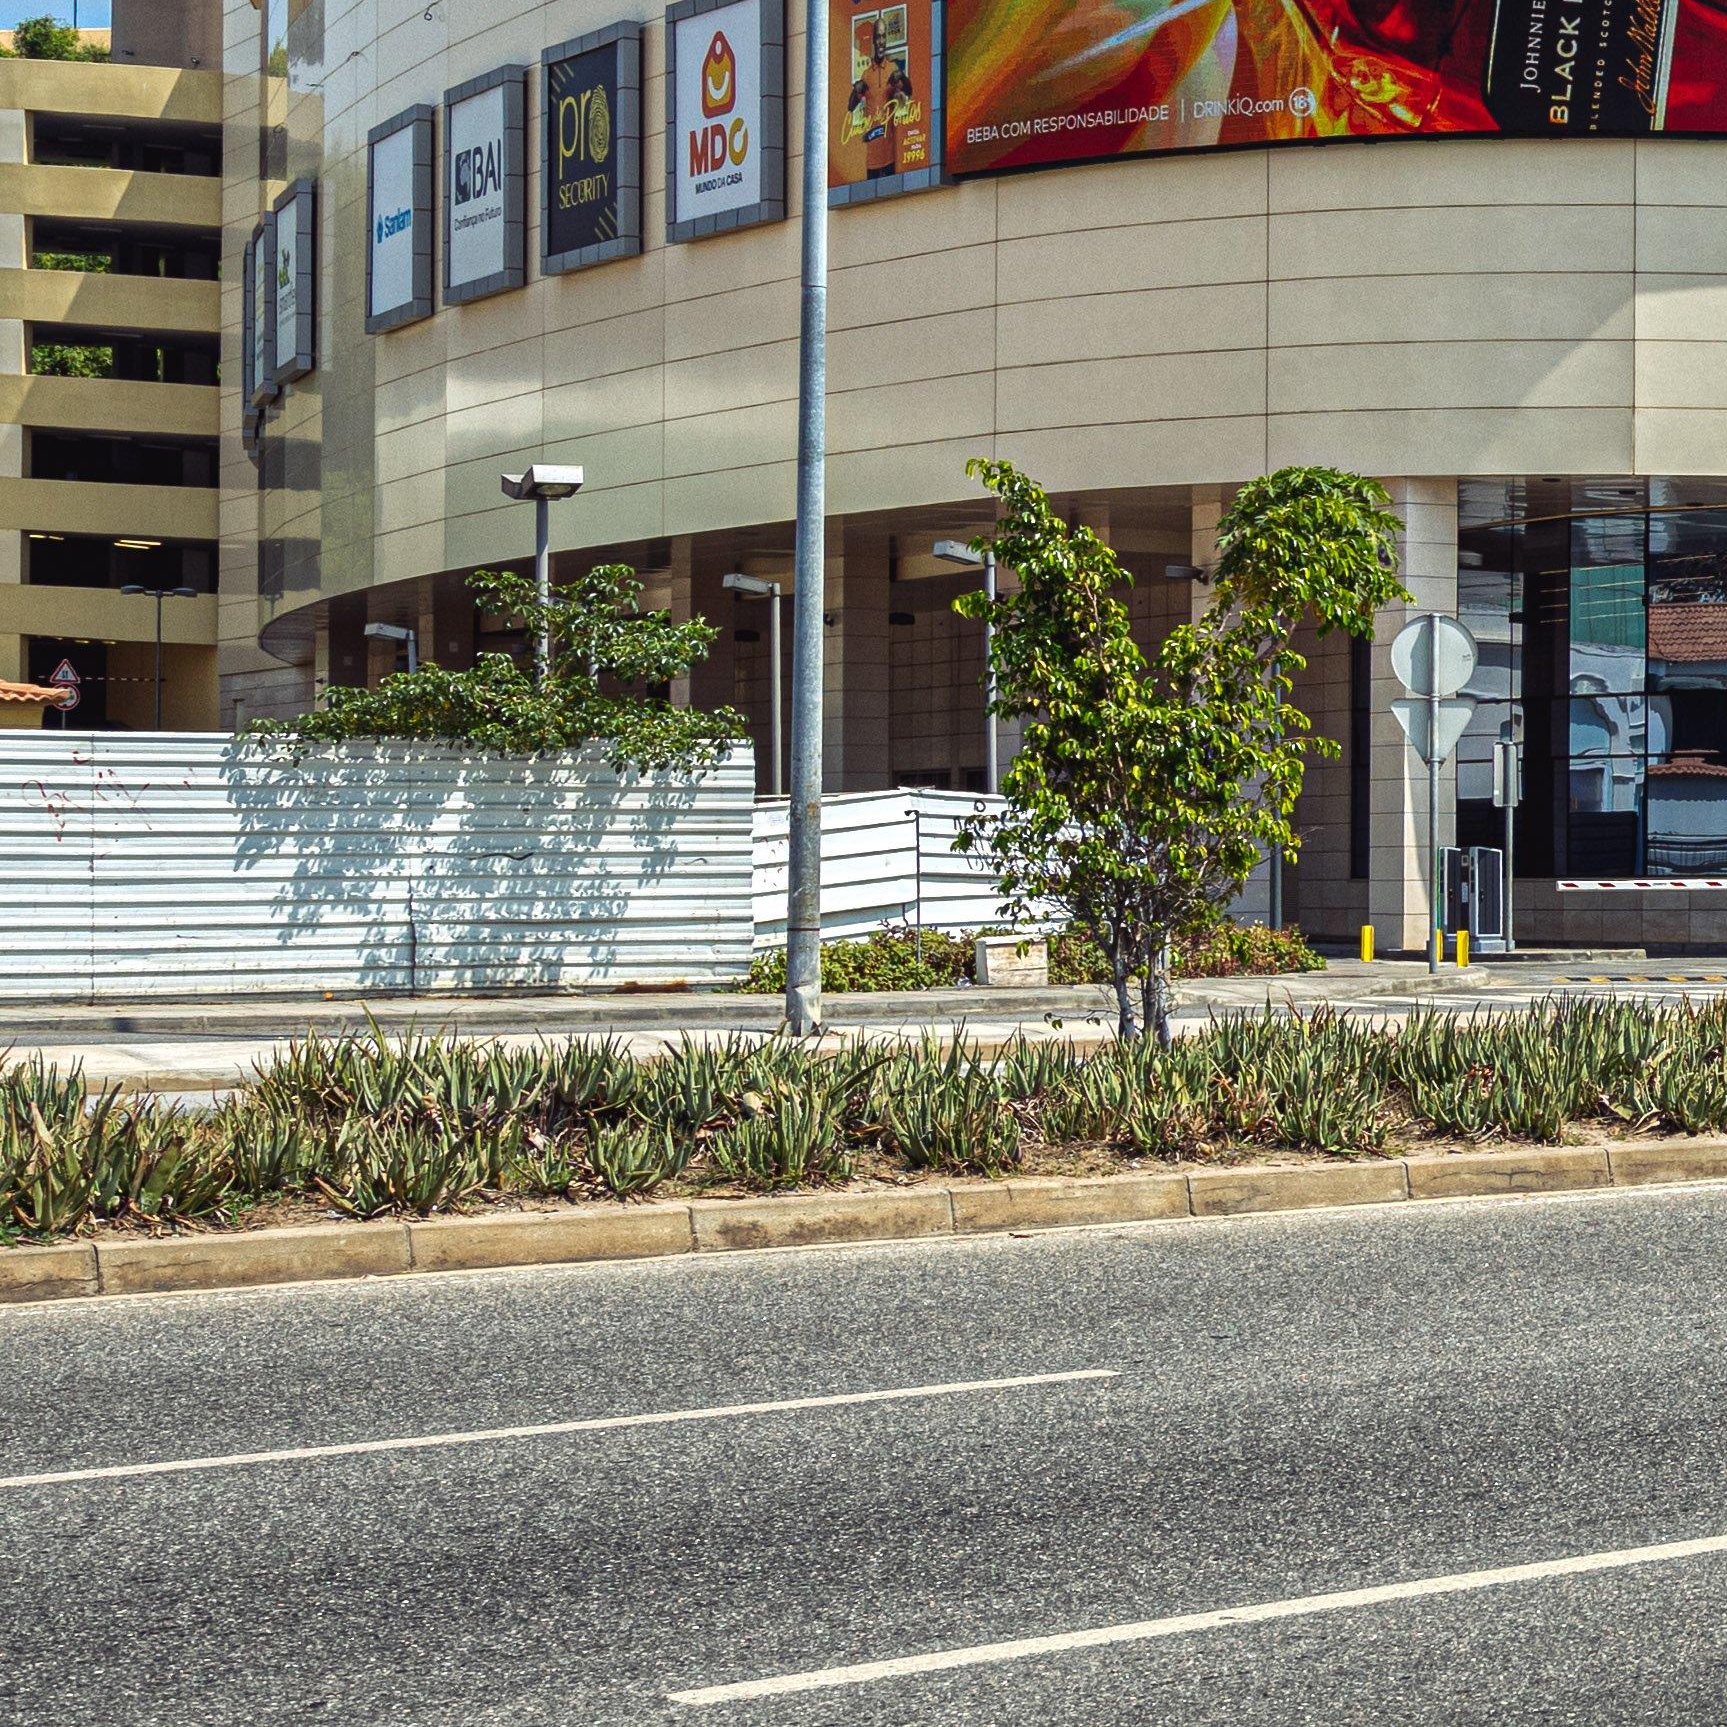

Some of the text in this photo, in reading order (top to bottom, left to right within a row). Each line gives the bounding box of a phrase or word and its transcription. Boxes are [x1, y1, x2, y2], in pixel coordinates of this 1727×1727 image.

[1520, 0, 1547, 93] JOHNNIE
[1550, 16, 1582, 124] BLACK
[1589, 59, 1606, 130] BLENDED
[966, 126, 999, 144] BEBA
[1001, 121, 1031, 138] COM
[1034, 104, 1170, 134] RESPONSABILIDADE
[472, 139, 502, 200] BAI
[559, 172, 610, 209] SECURITY
[695, 178, 717, 195] MUNDO
[726, 172, 744, 188] CASA
[384, 208, 412, 239] Sanlam
